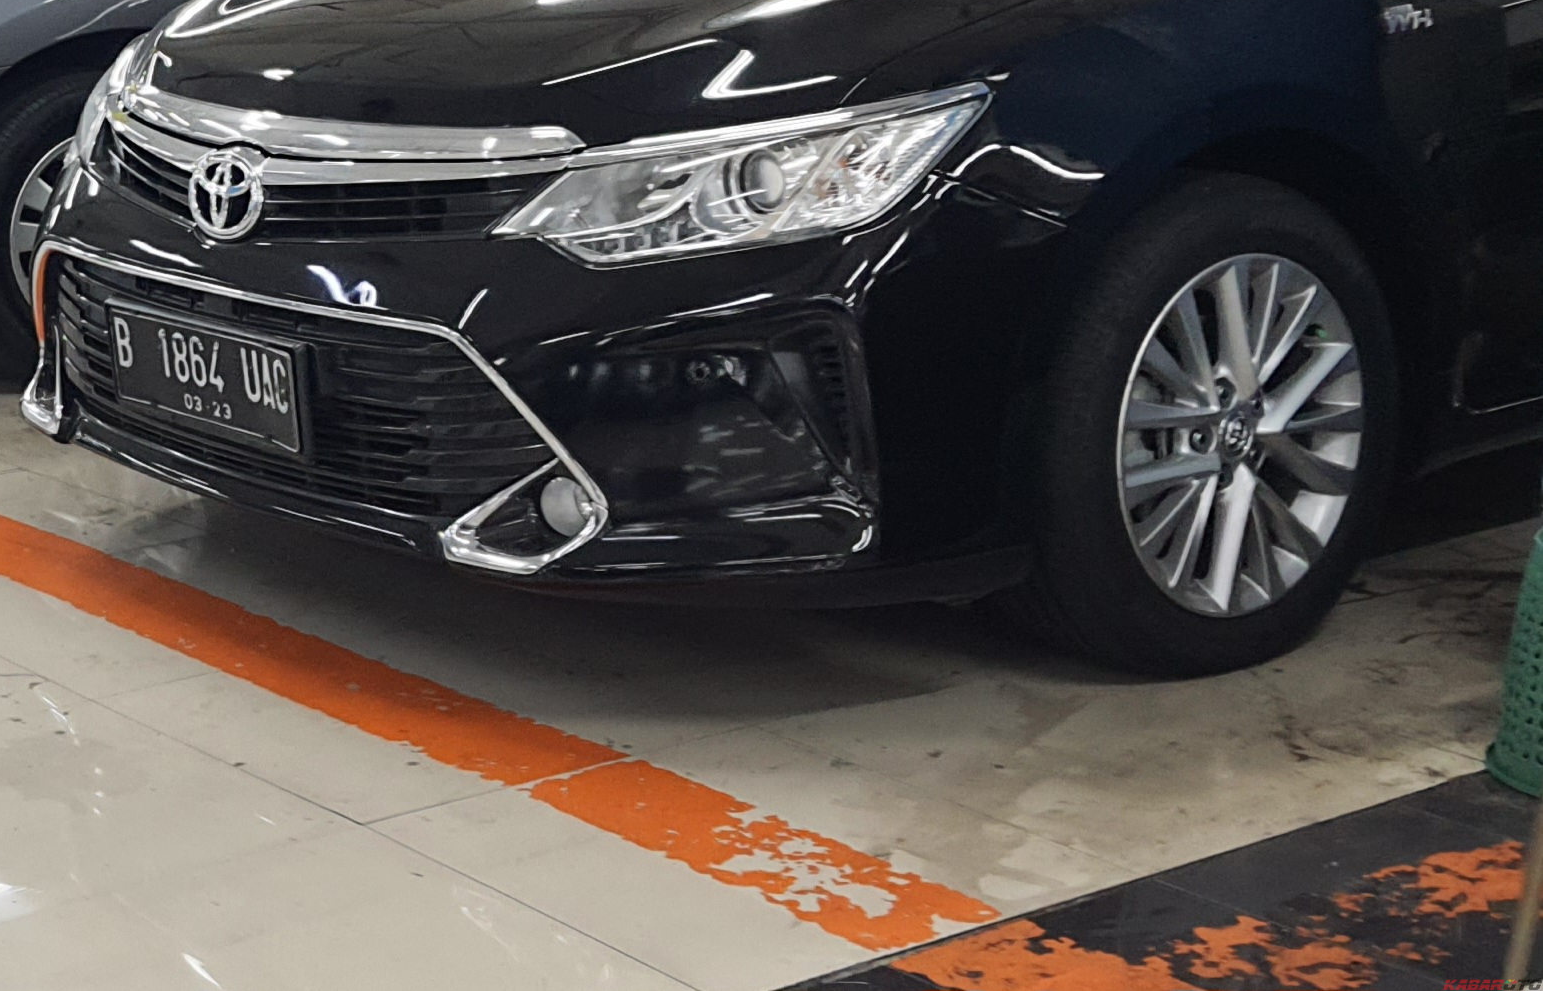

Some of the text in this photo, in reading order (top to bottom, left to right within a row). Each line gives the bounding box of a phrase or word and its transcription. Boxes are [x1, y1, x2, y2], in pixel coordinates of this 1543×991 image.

[113, 316, 290, 415] B 1864 UAC
